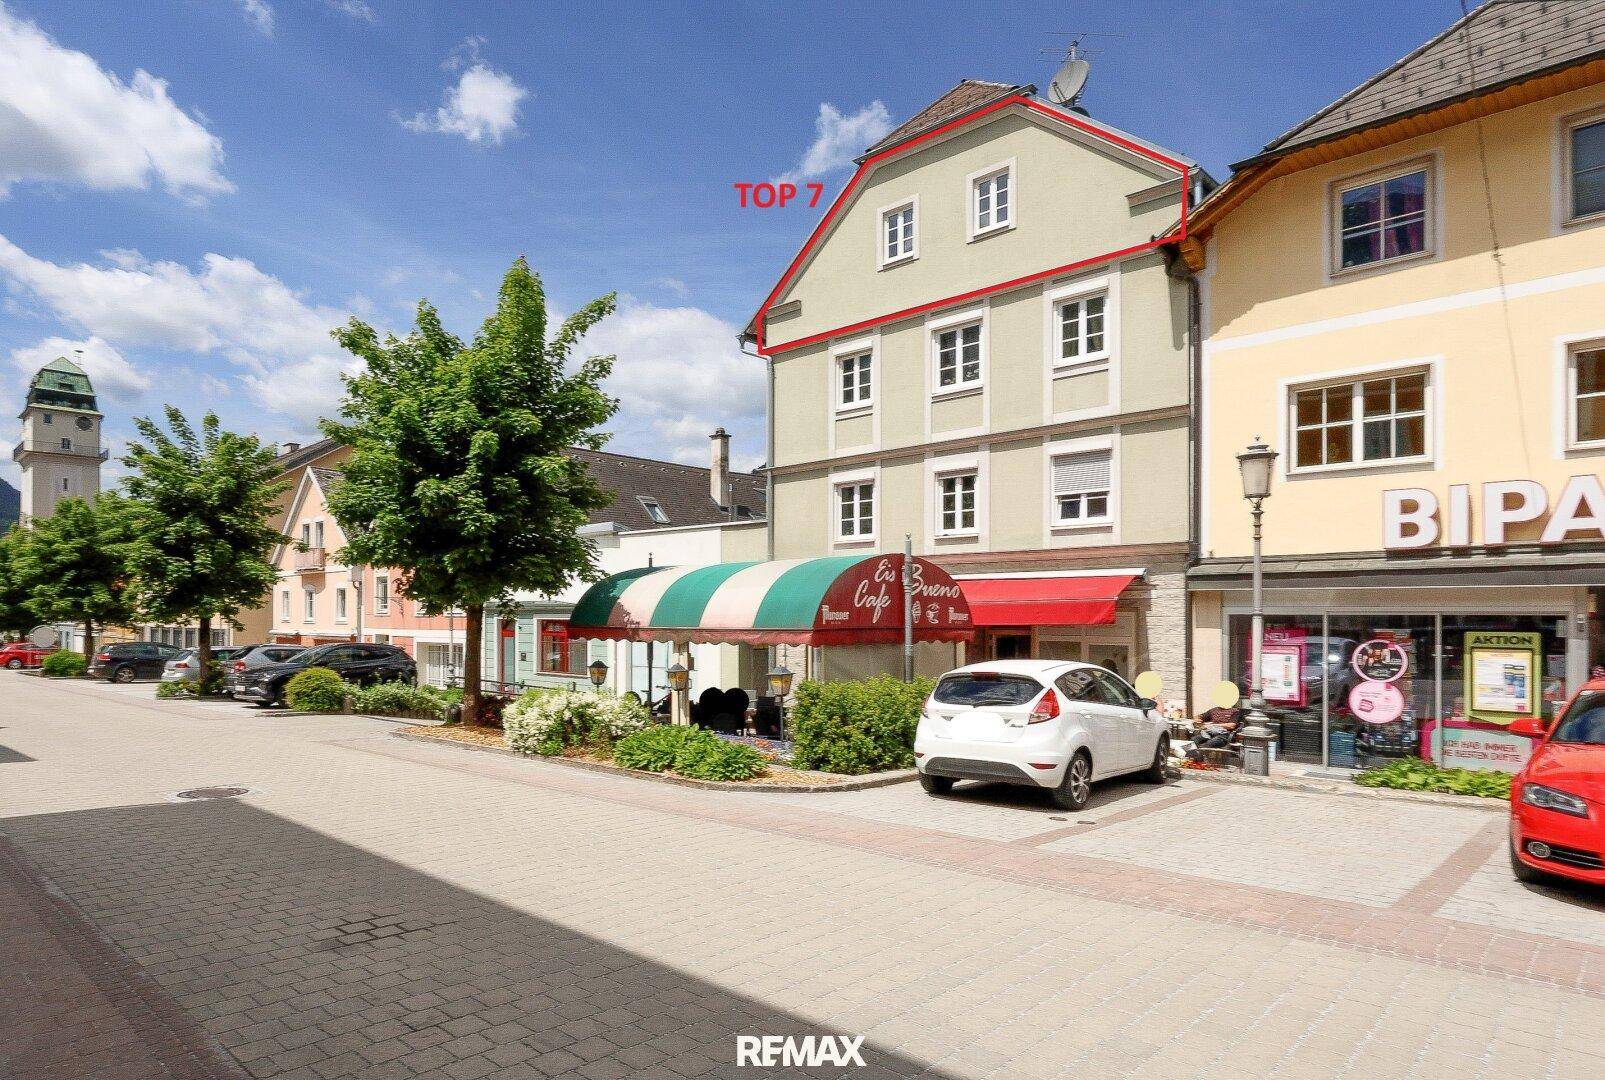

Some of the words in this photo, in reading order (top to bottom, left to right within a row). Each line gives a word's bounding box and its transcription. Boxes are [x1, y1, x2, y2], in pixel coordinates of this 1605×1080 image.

[1382, 474, 1605, 549] BIPA
[874, 559, 895, 582] Eis
[901, 563, 960, 598] Bueno
[1473, 635, 1533, 645] AKTION
